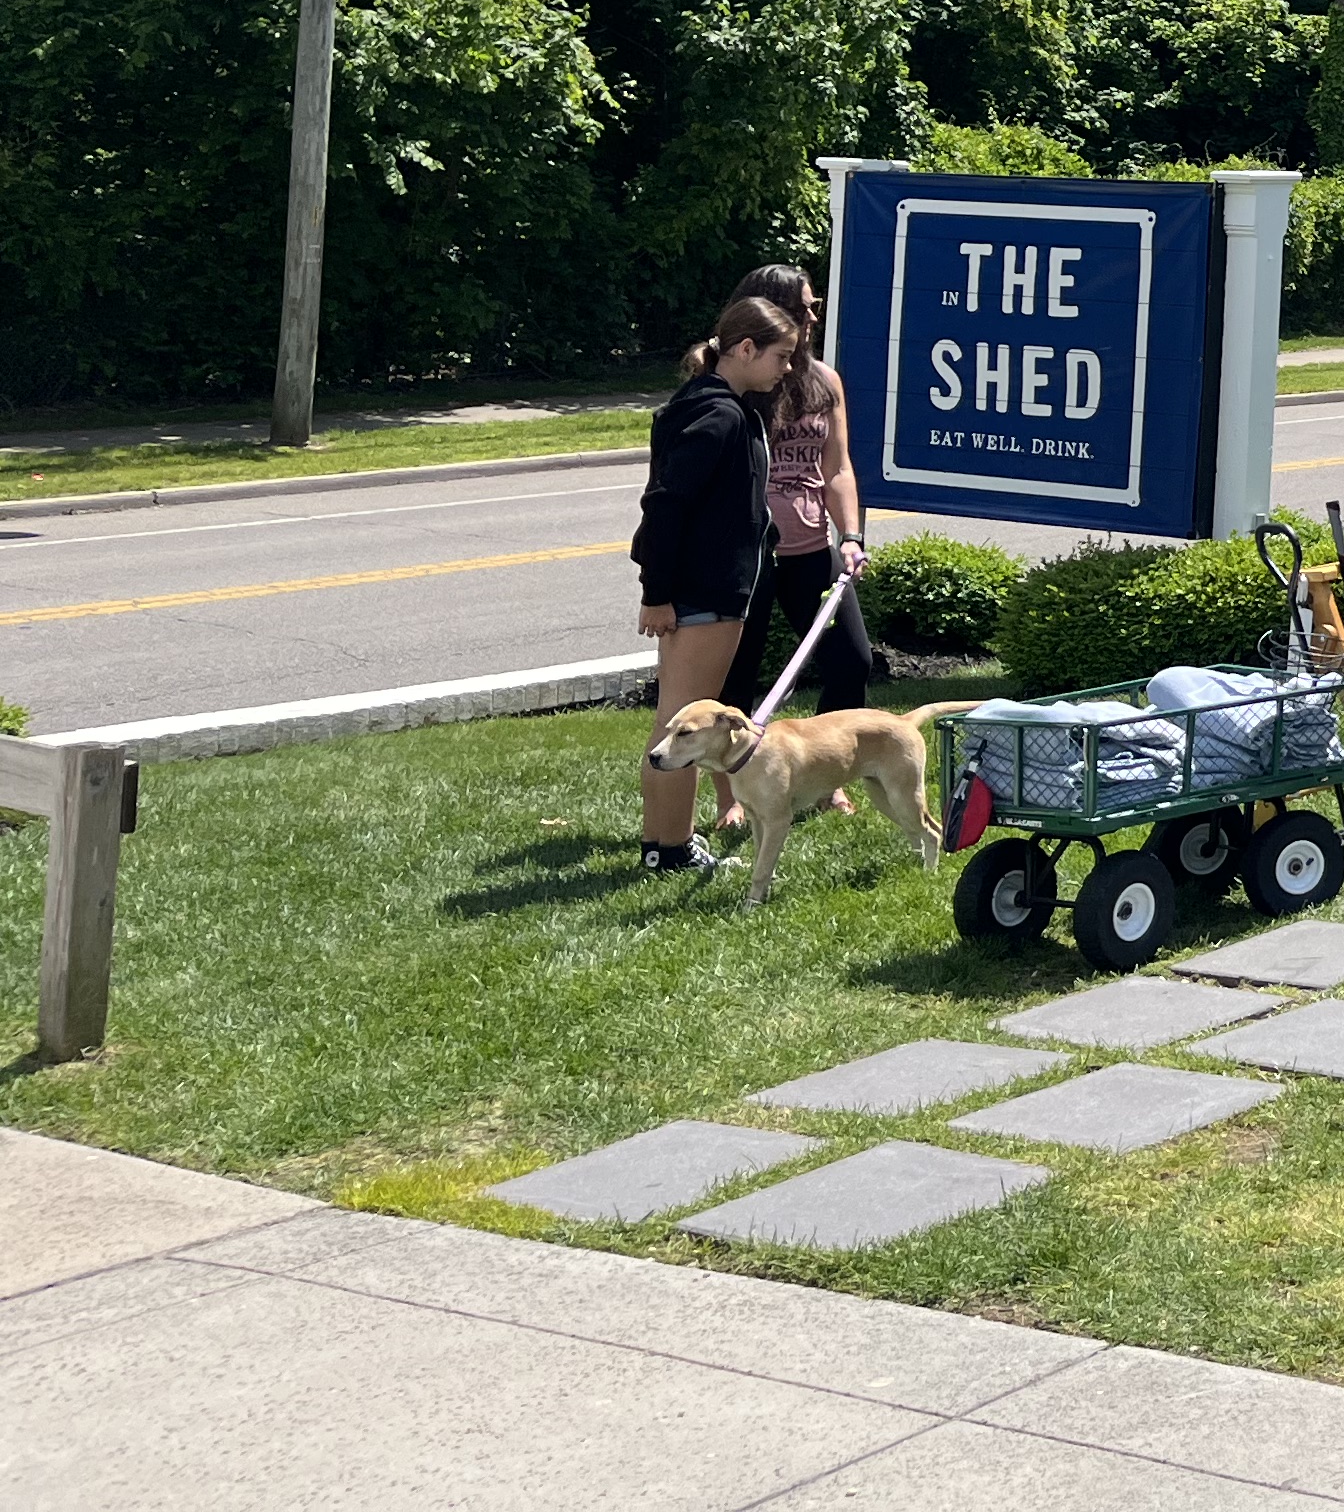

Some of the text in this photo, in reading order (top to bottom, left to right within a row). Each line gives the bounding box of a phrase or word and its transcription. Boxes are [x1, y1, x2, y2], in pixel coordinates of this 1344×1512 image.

[941, 290, 959, 307] IN
[959, 242, 1083, 318] THE
[929, 338, 1102, 420] SHED
[929, 429, 1095, 459] EAT WELL. DRINK.
